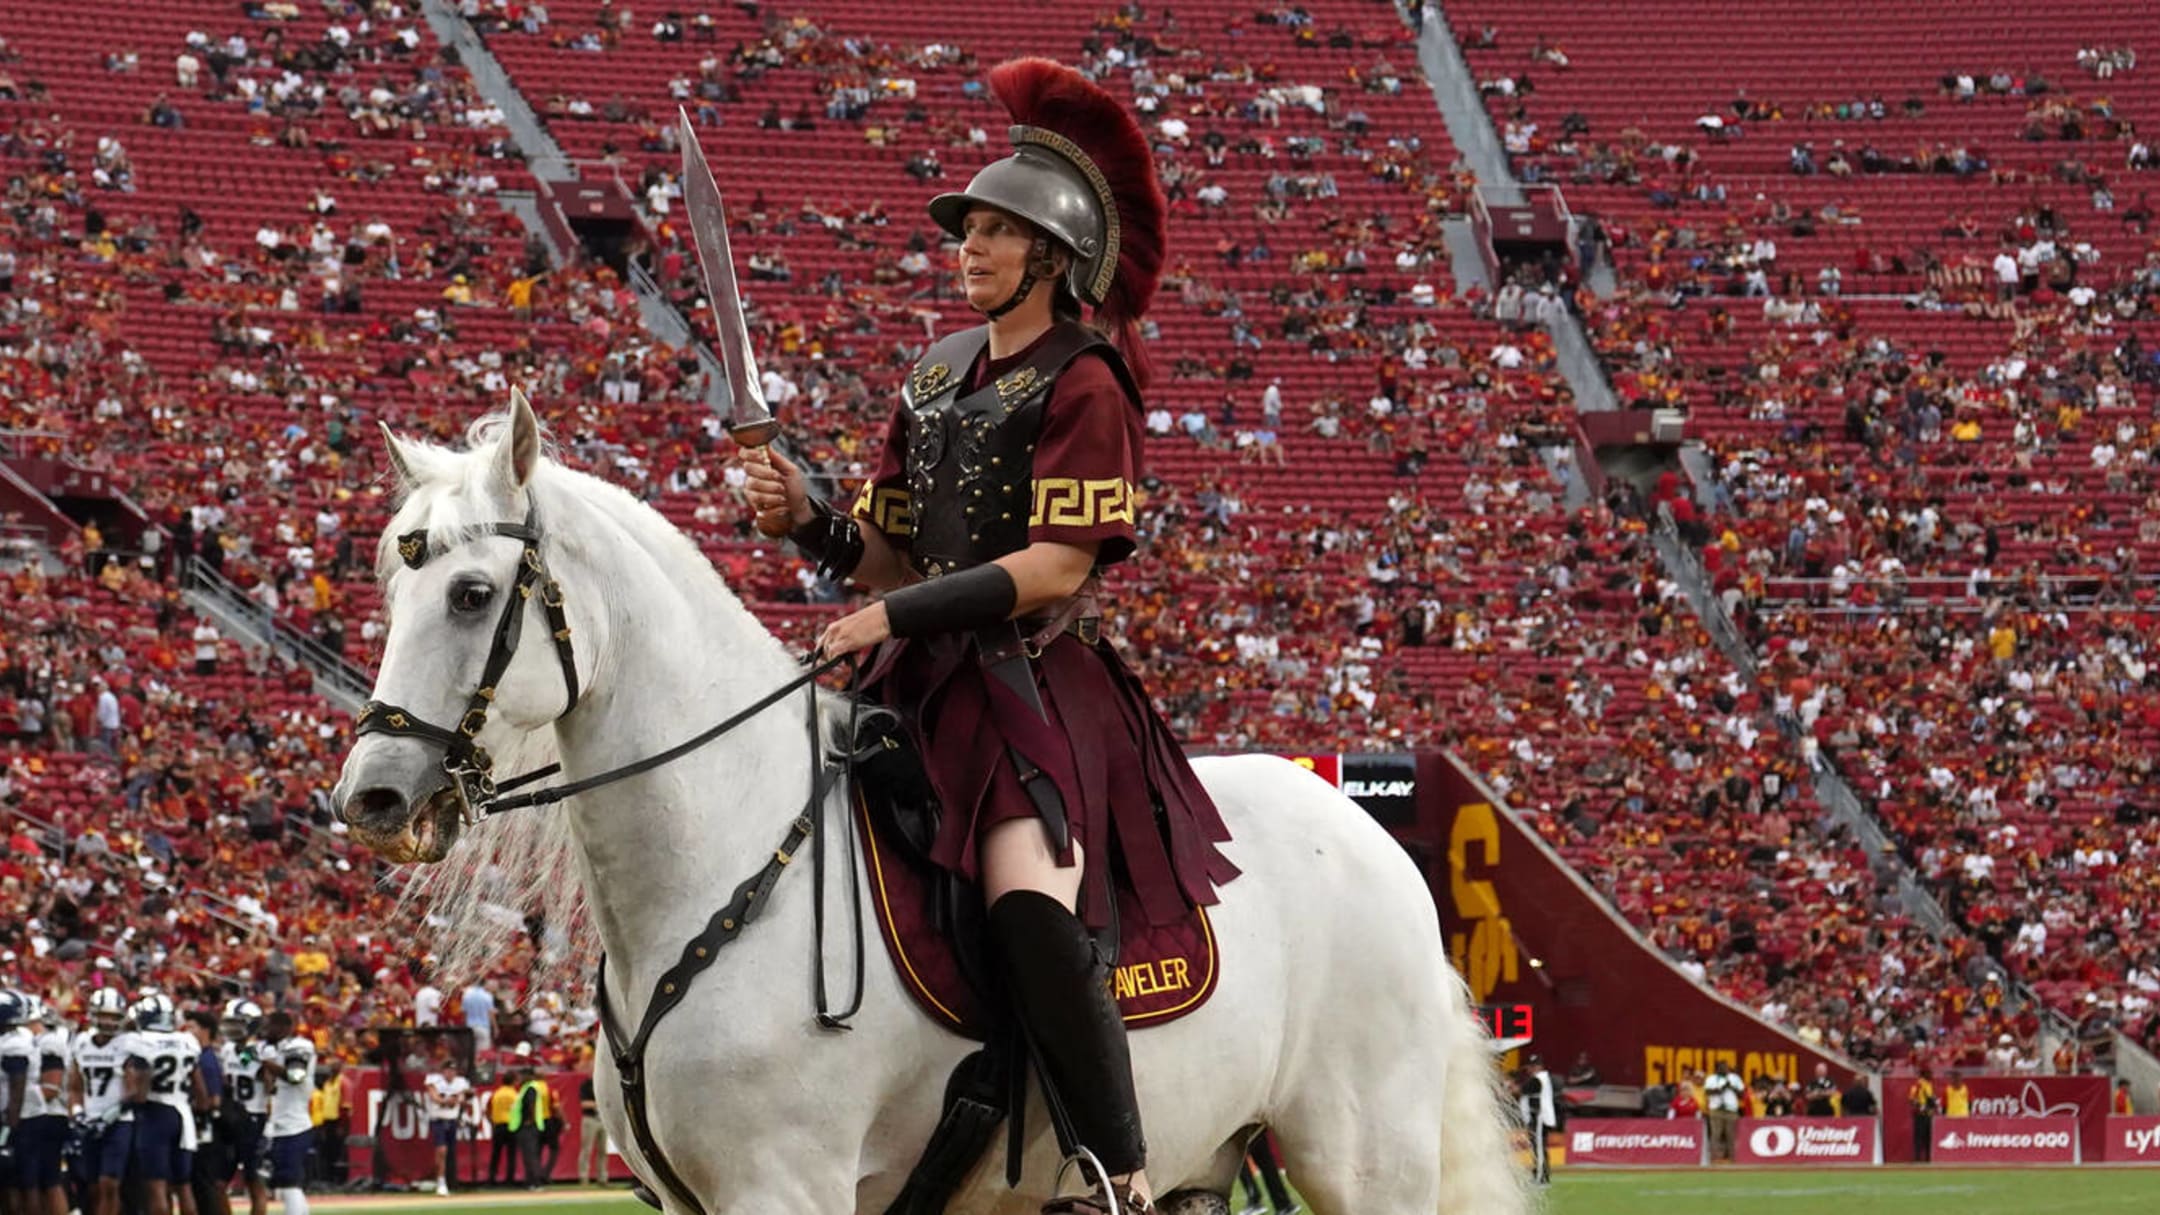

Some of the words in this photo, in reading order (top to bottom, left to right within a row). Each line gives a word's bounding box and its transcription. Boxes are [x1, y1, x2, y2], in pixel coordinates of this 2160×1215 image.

[1343, 781, 1414, 797] ELKAY
[1105, 958, 1191, 1000] AVELER
[83, 1066, 114, 1096] 17
[1972, 1094, 2019, 1117] ren's
[1797, 1126, 1857, 1142] United
[1967, 1131, 2032, 1148] Invesco
[1795, 1142, 1860, 1156] Rentals
